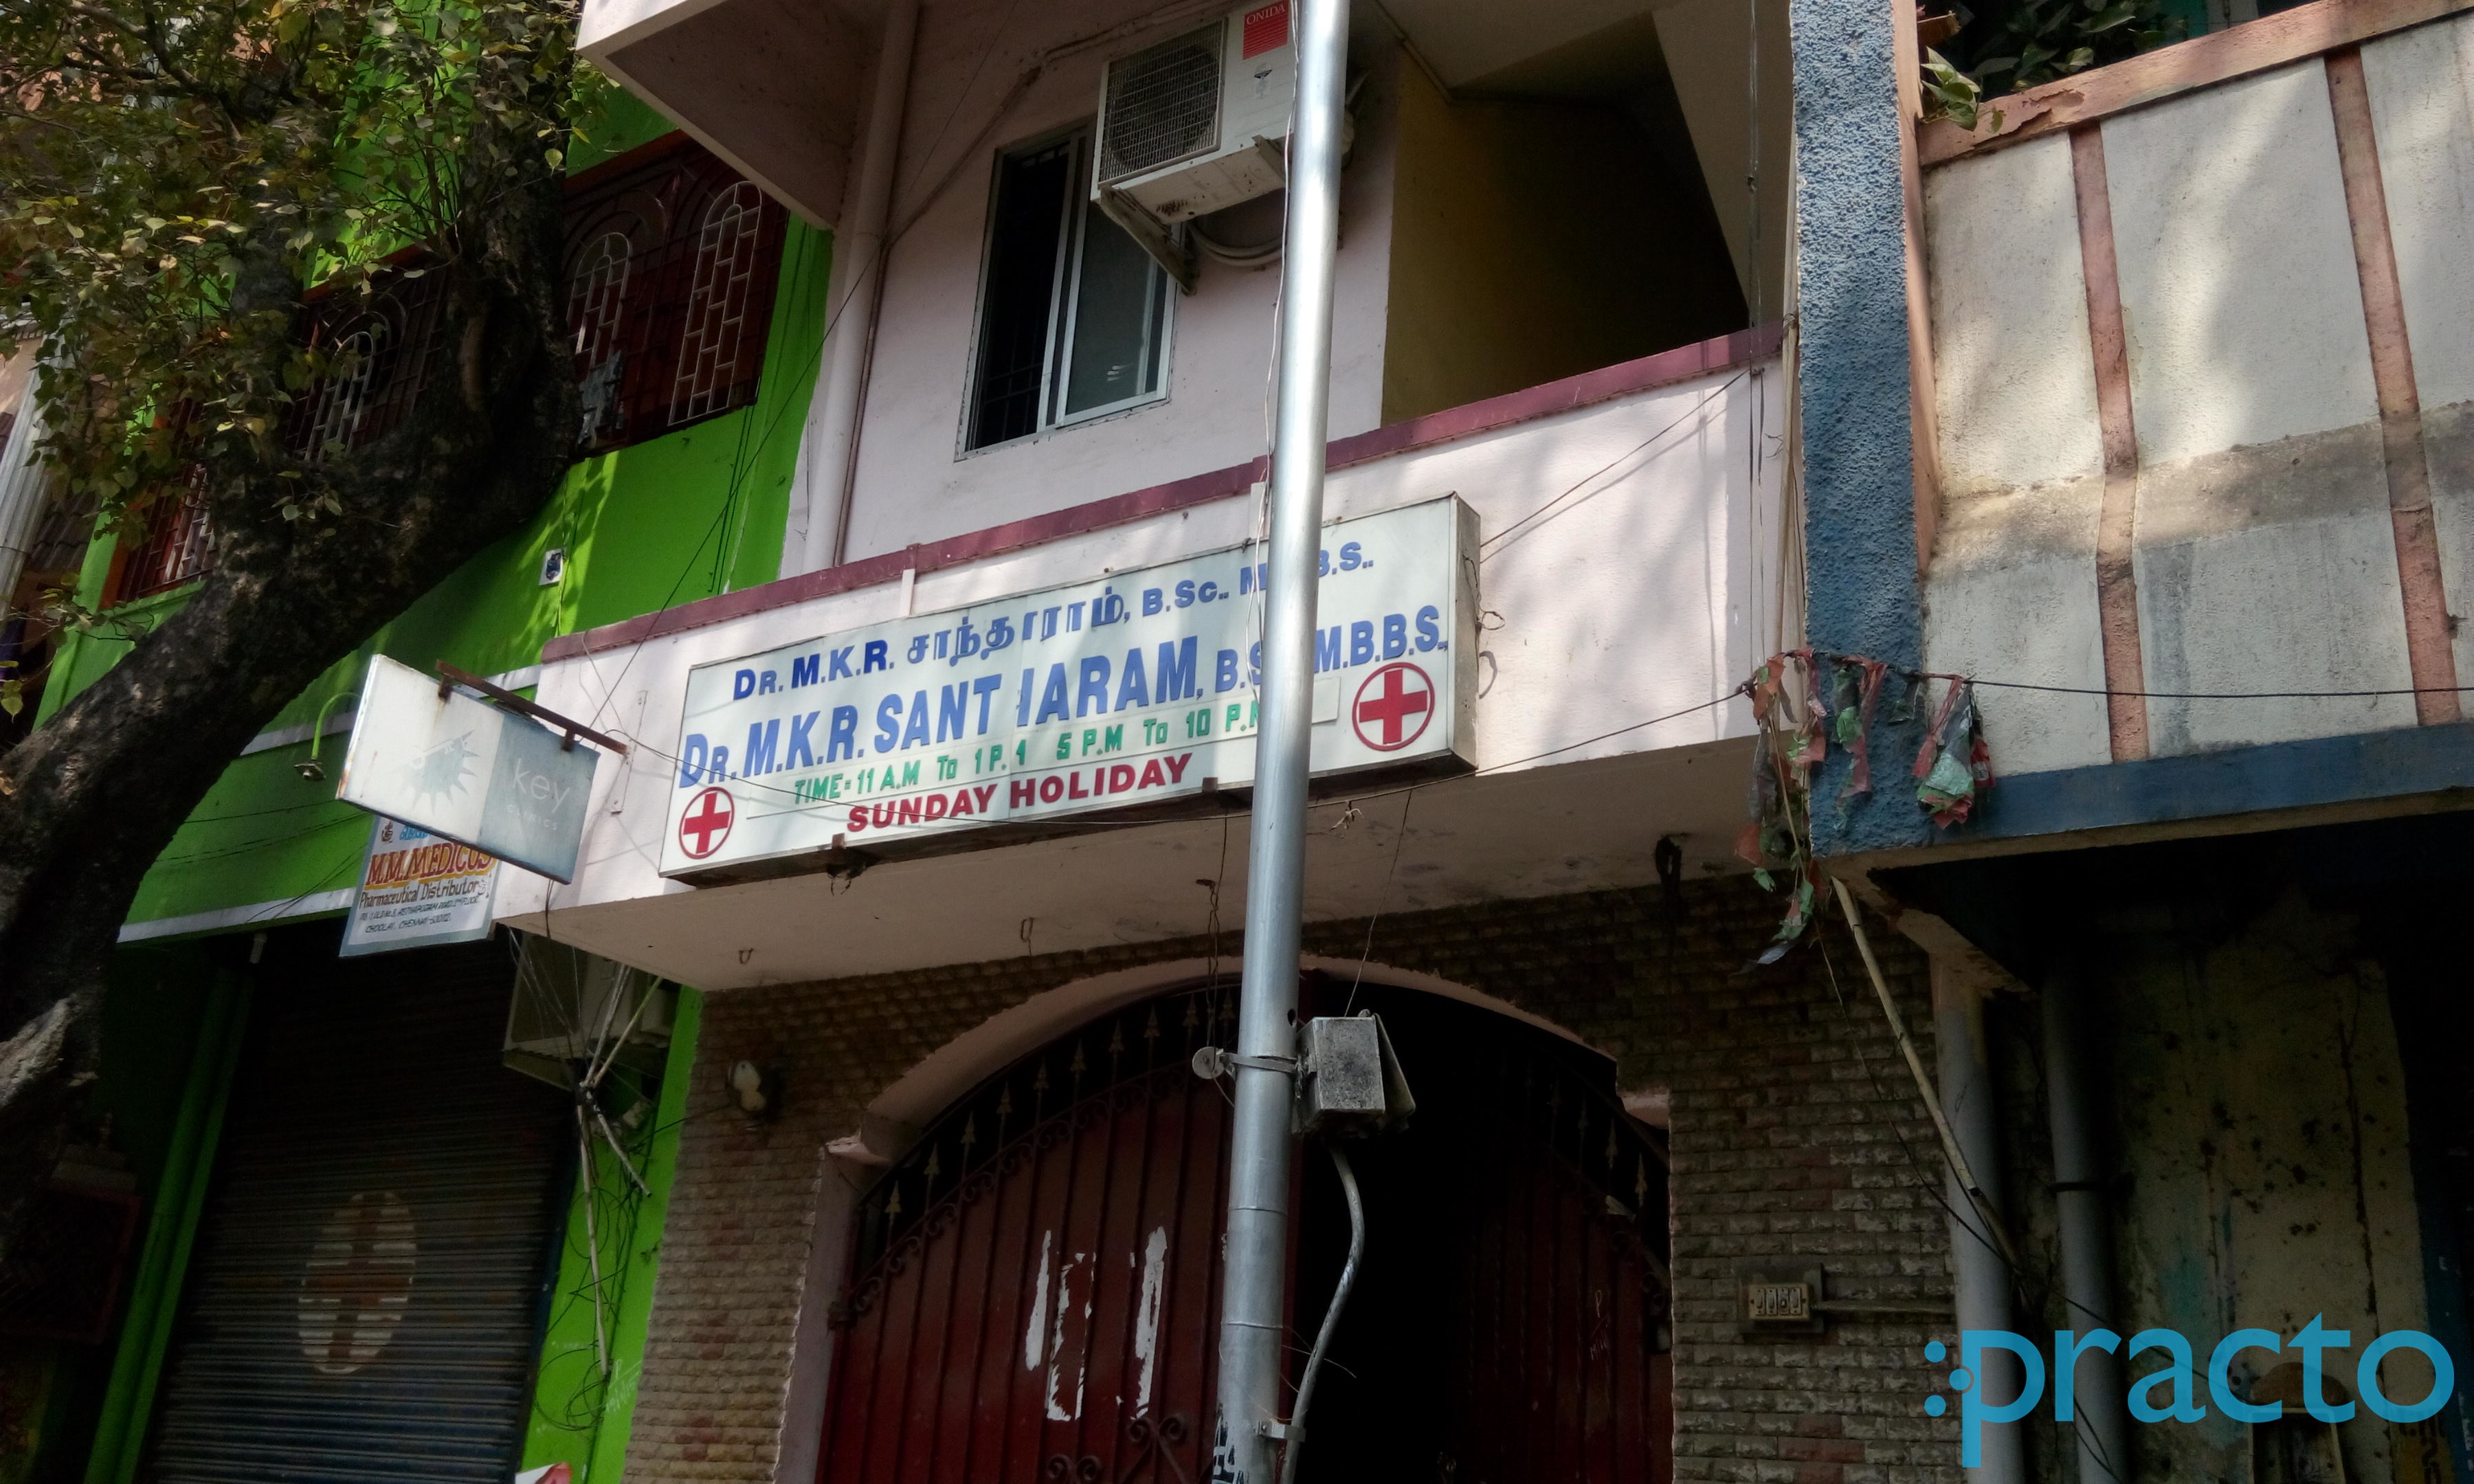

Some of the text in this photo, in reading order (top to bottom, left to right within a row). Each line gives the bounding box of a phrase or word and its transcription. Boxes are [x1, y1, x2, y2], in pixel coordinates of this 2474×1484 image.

[1247, 3, 1286, 25] ONIDA
[791, 639, 894, 688] M.K.R.
[743, 705, 864, 778] M.K.R.
[1186, 708, 1211, 739] 10
[512, 758, 570, 813] key
[847, 753, 1193, 833] SUNDAY HOLIDAY
[358, 884, 420, 910] Pharmaceutical
